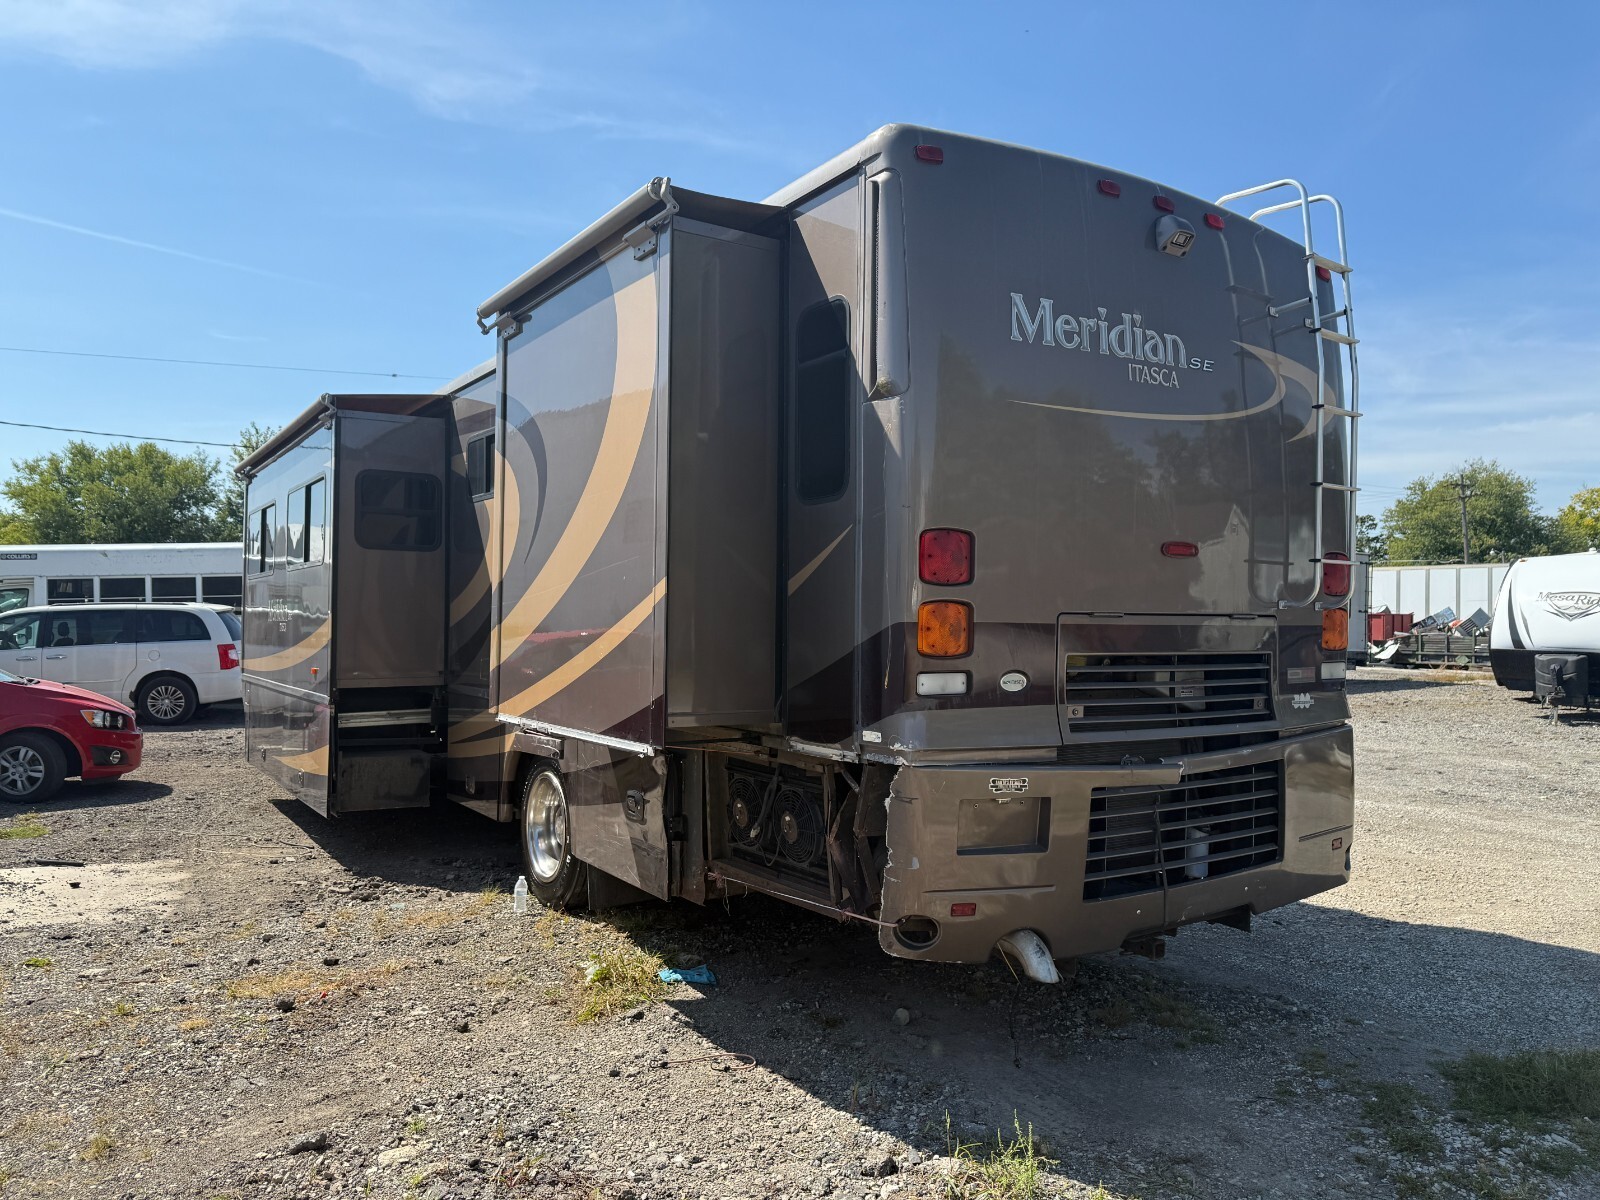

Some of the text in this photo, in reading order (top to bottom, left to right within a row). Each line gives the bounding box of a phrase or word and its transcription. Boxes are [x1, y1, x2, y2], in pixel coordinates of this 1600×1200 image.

[1010, 292, 1215, 372] Meridian SE
[1128, 363, 1180, 389] ITASCA
[1536, 591, 1576, 602] Mesa
